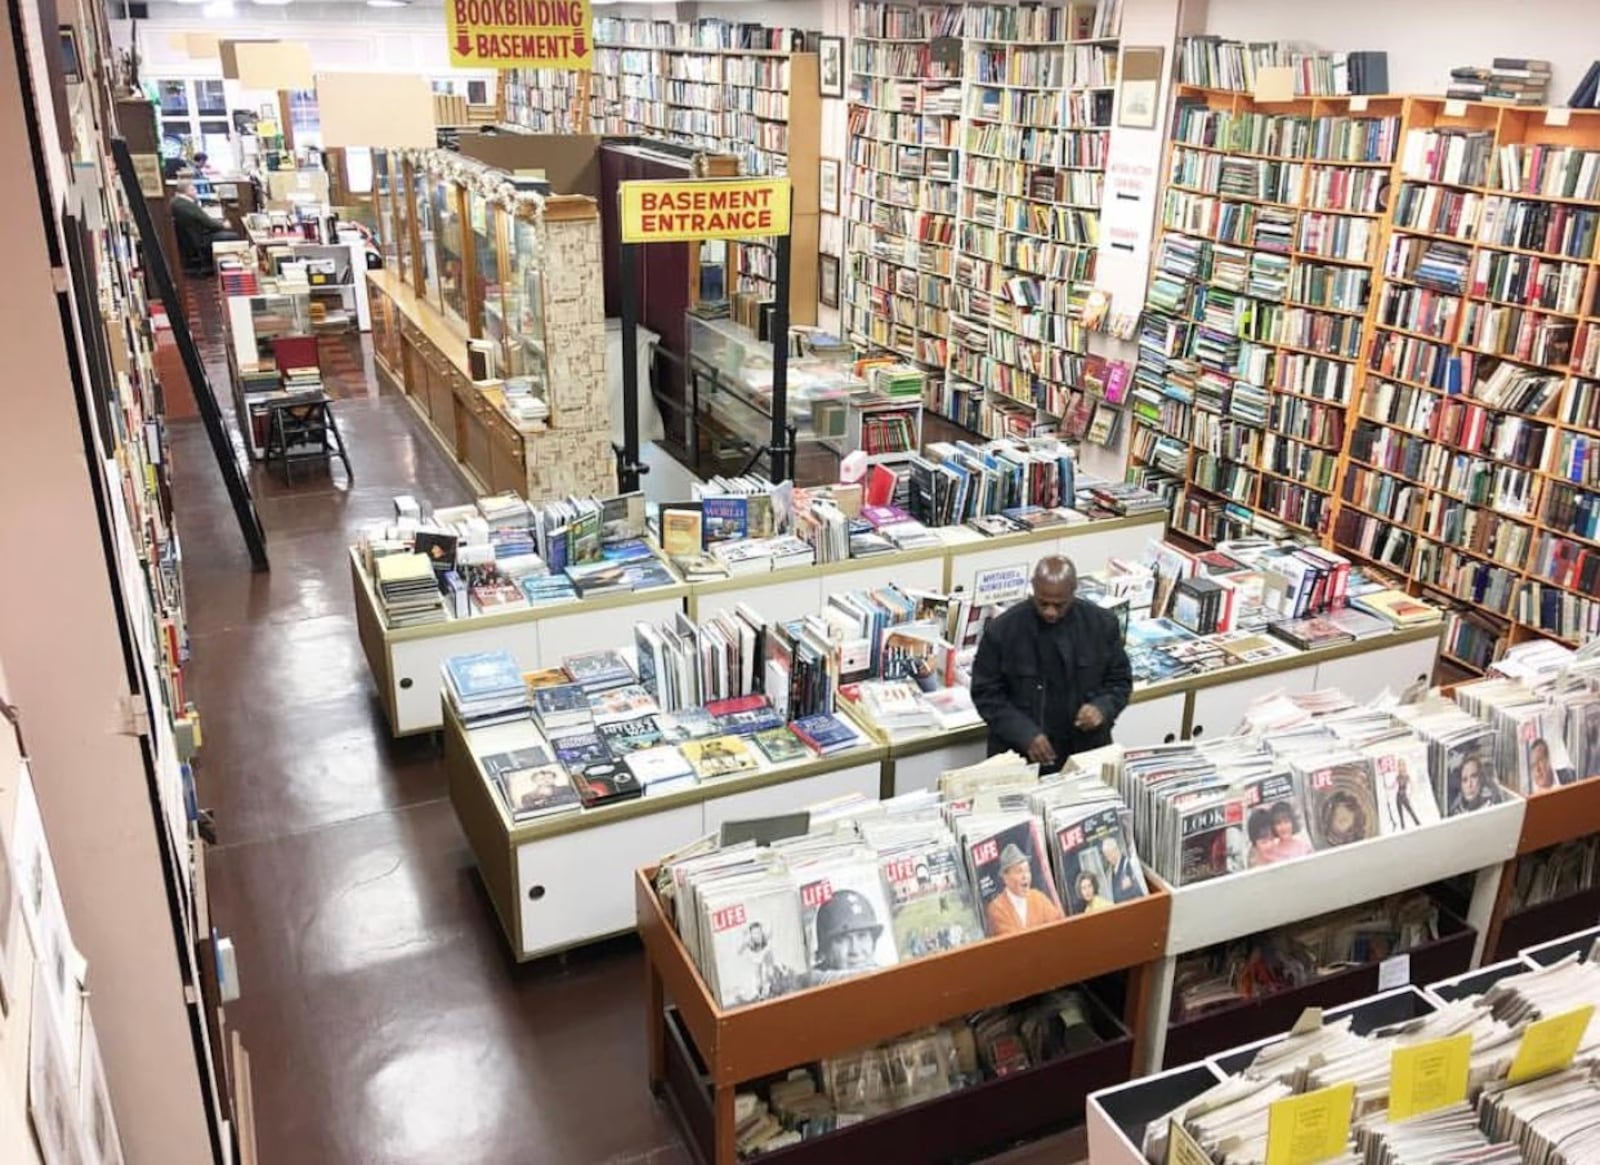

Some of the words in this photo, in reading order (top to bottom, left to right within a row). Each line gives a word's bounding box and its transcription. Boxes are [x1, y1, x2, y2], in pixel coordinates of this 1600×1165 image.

[455, 0, 583, 26] BOOKBINDING
[477, 34, 570, 58] BASEMENT
[641, 188, 773, 211] BASEMENT
[641, 210, 772, 232] ENTRANCE
[1311, 770, 1334, 790] LIFE
[1183, 809, 1225, 834] LOOK
[1060, 825, 1085, 852] LIFE
[972, 839, 999, 867] LIFE
[887, 856, 914, 882] LIFE
[803, 880, 834, 906] LIFE
[714, 904, 746, 931] LIFE
